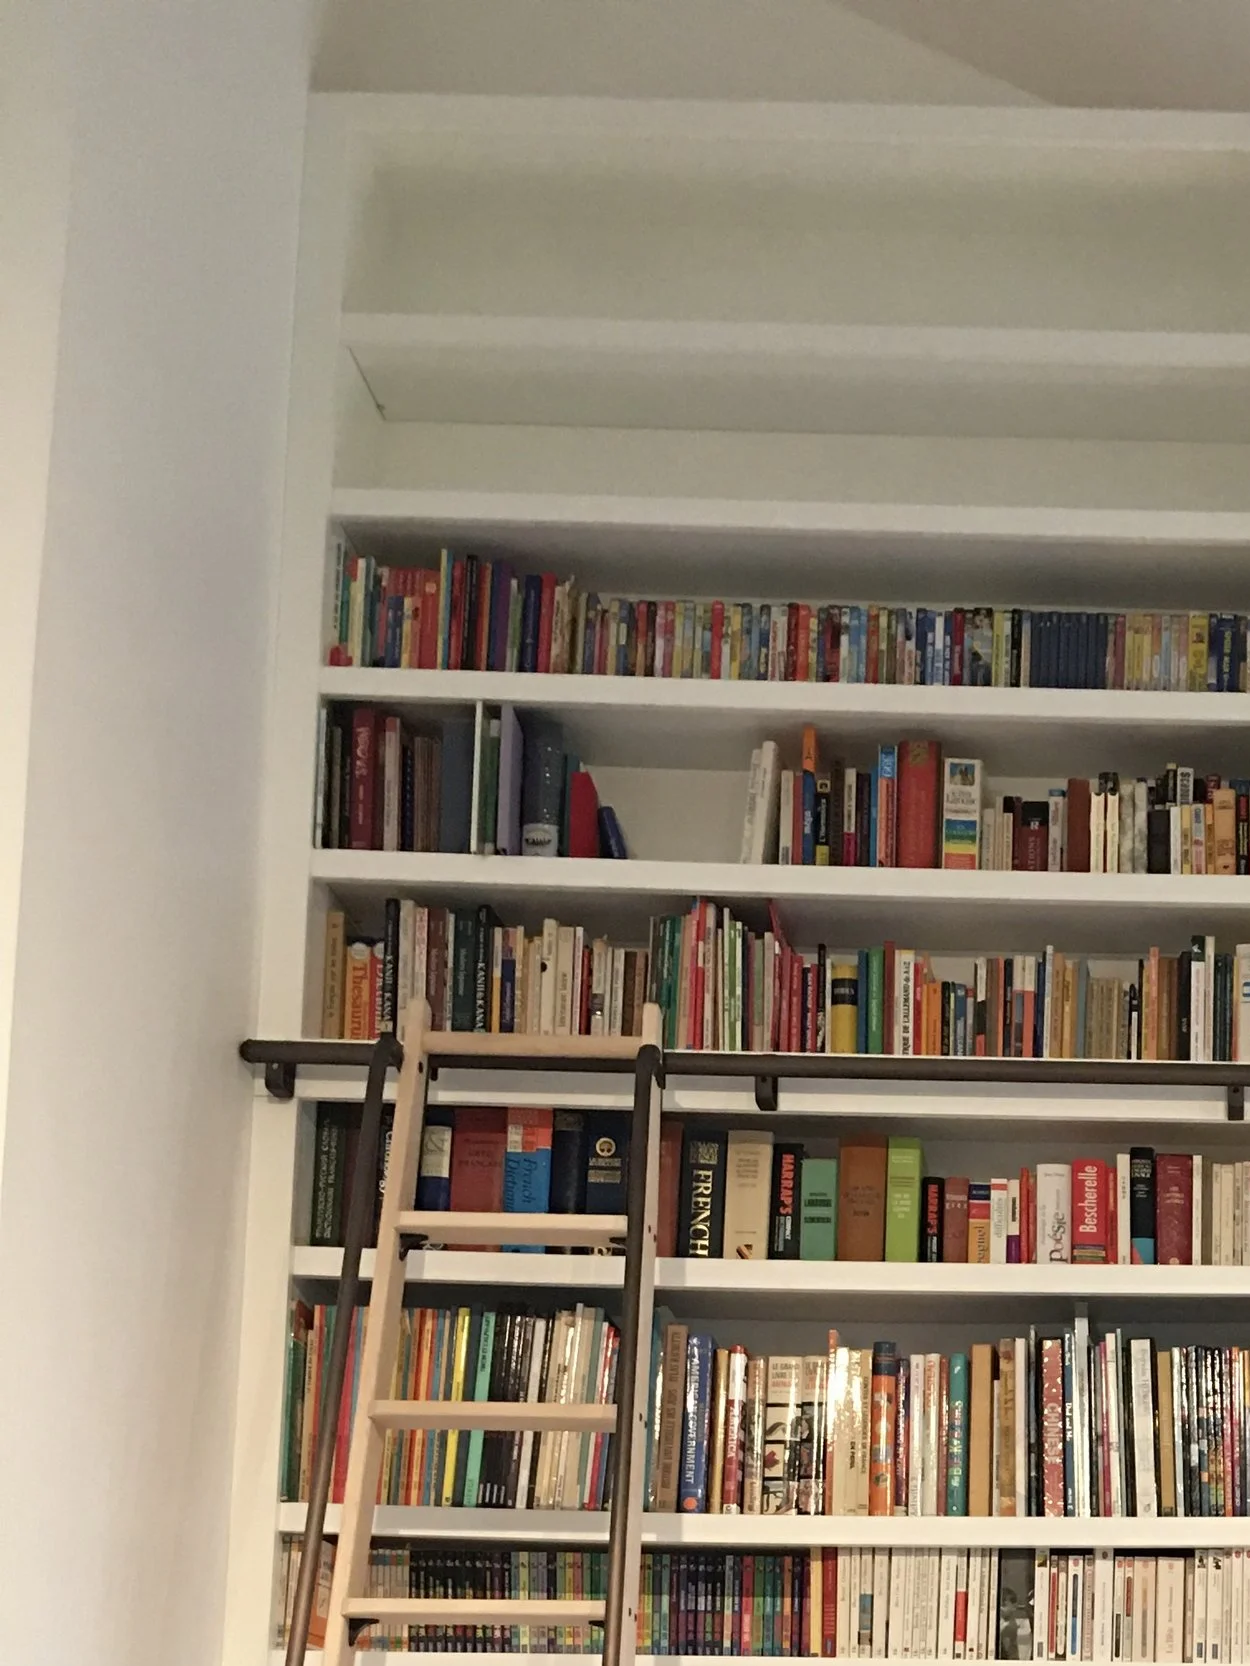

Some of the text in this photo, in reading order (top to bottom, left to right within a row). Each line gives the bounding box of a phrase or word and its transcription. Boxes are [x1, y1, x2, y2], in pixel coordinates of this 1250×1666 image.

[351, 965, 369, 1040] Thesauru
[382, 955, 394, 1021] KANJI KANA
[523, 1159, 537, 1204] French
[689, 1169, 713, 1256] FRENCH
[780, 1154, 795, 1214] HARRAP'S
[927, 1184, 939, 1233] HARRAP'S
[1080, 1166, 1098, 1234] Bescherelle
[1042, 1212, 1067, 1264] poésie
[685, 1357, 699, 1484] AMERICAN GOVERNMENT
[726, 1406, 736, 1458] AMERICA
[1046, 1402, 1058, 1465] CHINESE
